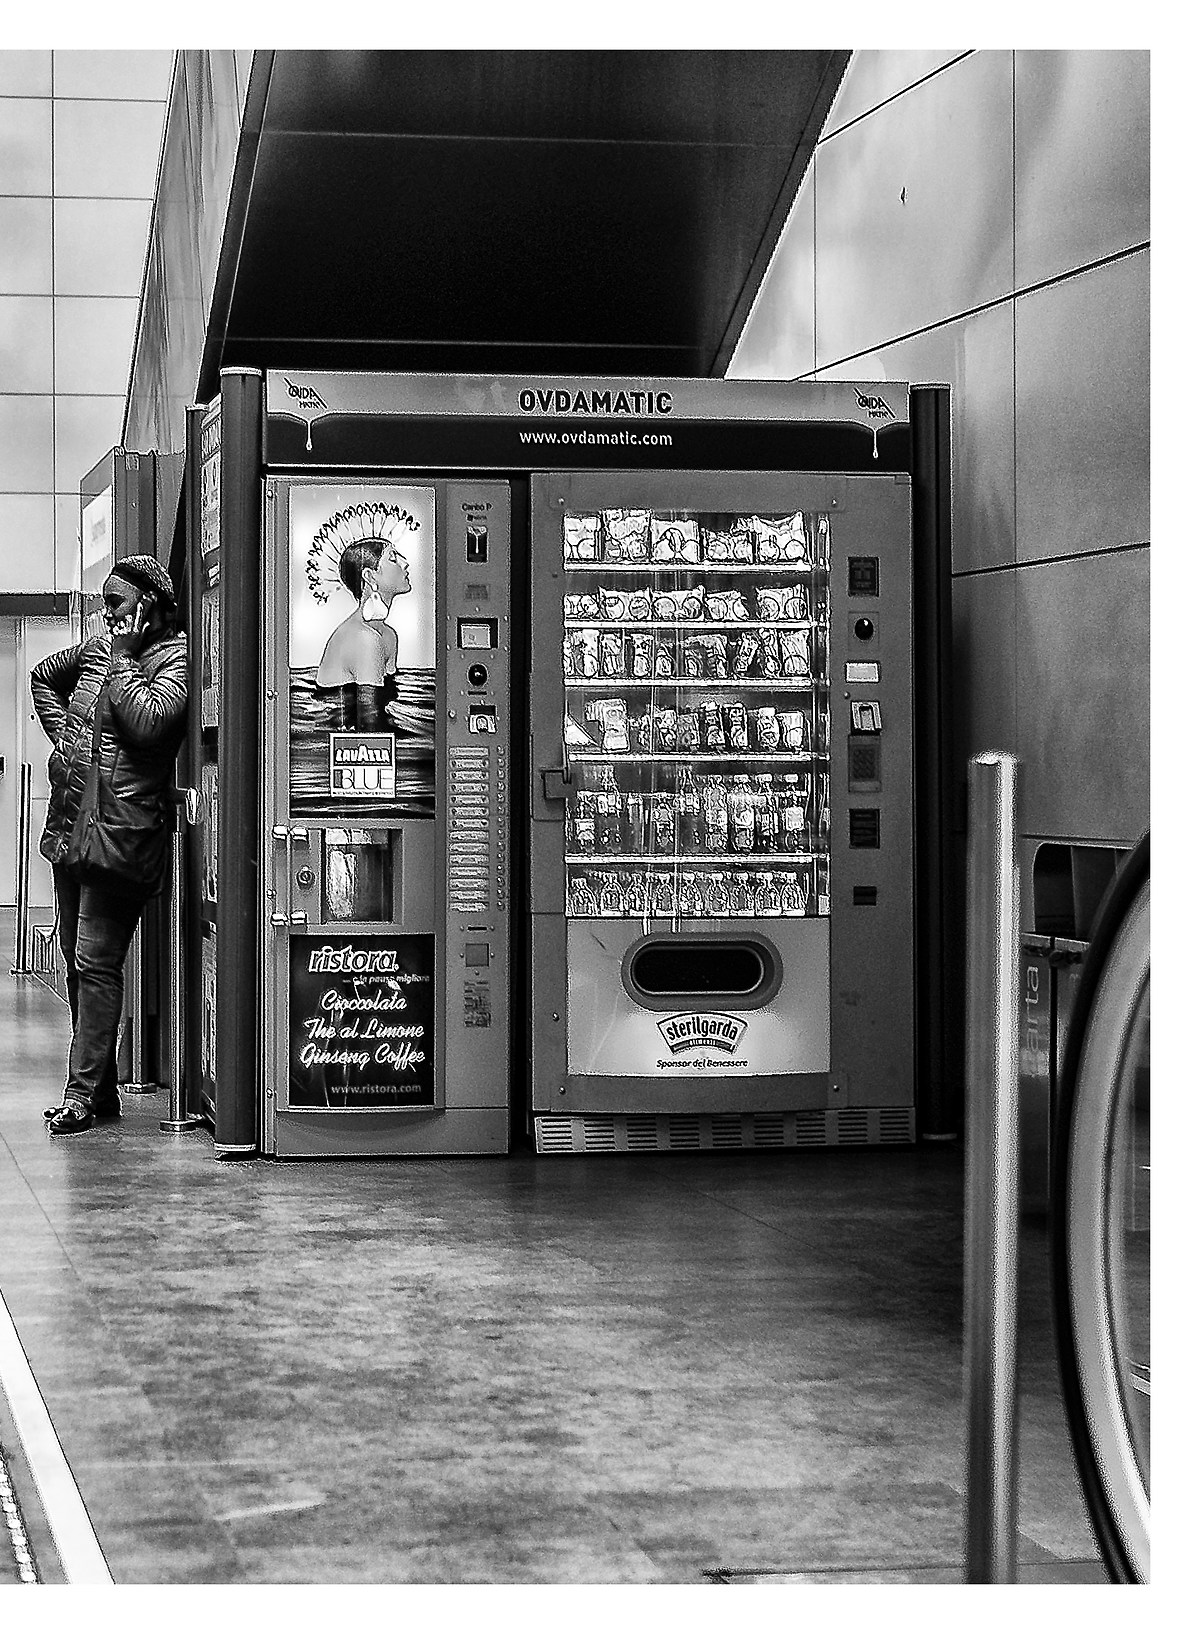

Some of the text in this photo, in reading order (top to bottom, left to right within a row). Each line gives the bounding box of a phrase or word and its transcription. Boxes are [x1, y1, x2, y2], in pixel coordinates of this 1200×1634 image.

[519, 389, 673, 414] OVDAMATIC
[519, 431, 673, 446] www.ovdamatic.com
[335, 744, 390, 762] LAVAZZA
[333, 768, 393, 790] BLUE
[303, 1017, 425, 1040] The al Limone
[667, 1016, 738, 1040] sterilgarda
[299, 1041, 426, 1071] Ginseng Coffee
[657, 1060, 691, 1069] Sponsor
[331, 1083, 422, 1094] www.ristora.com
